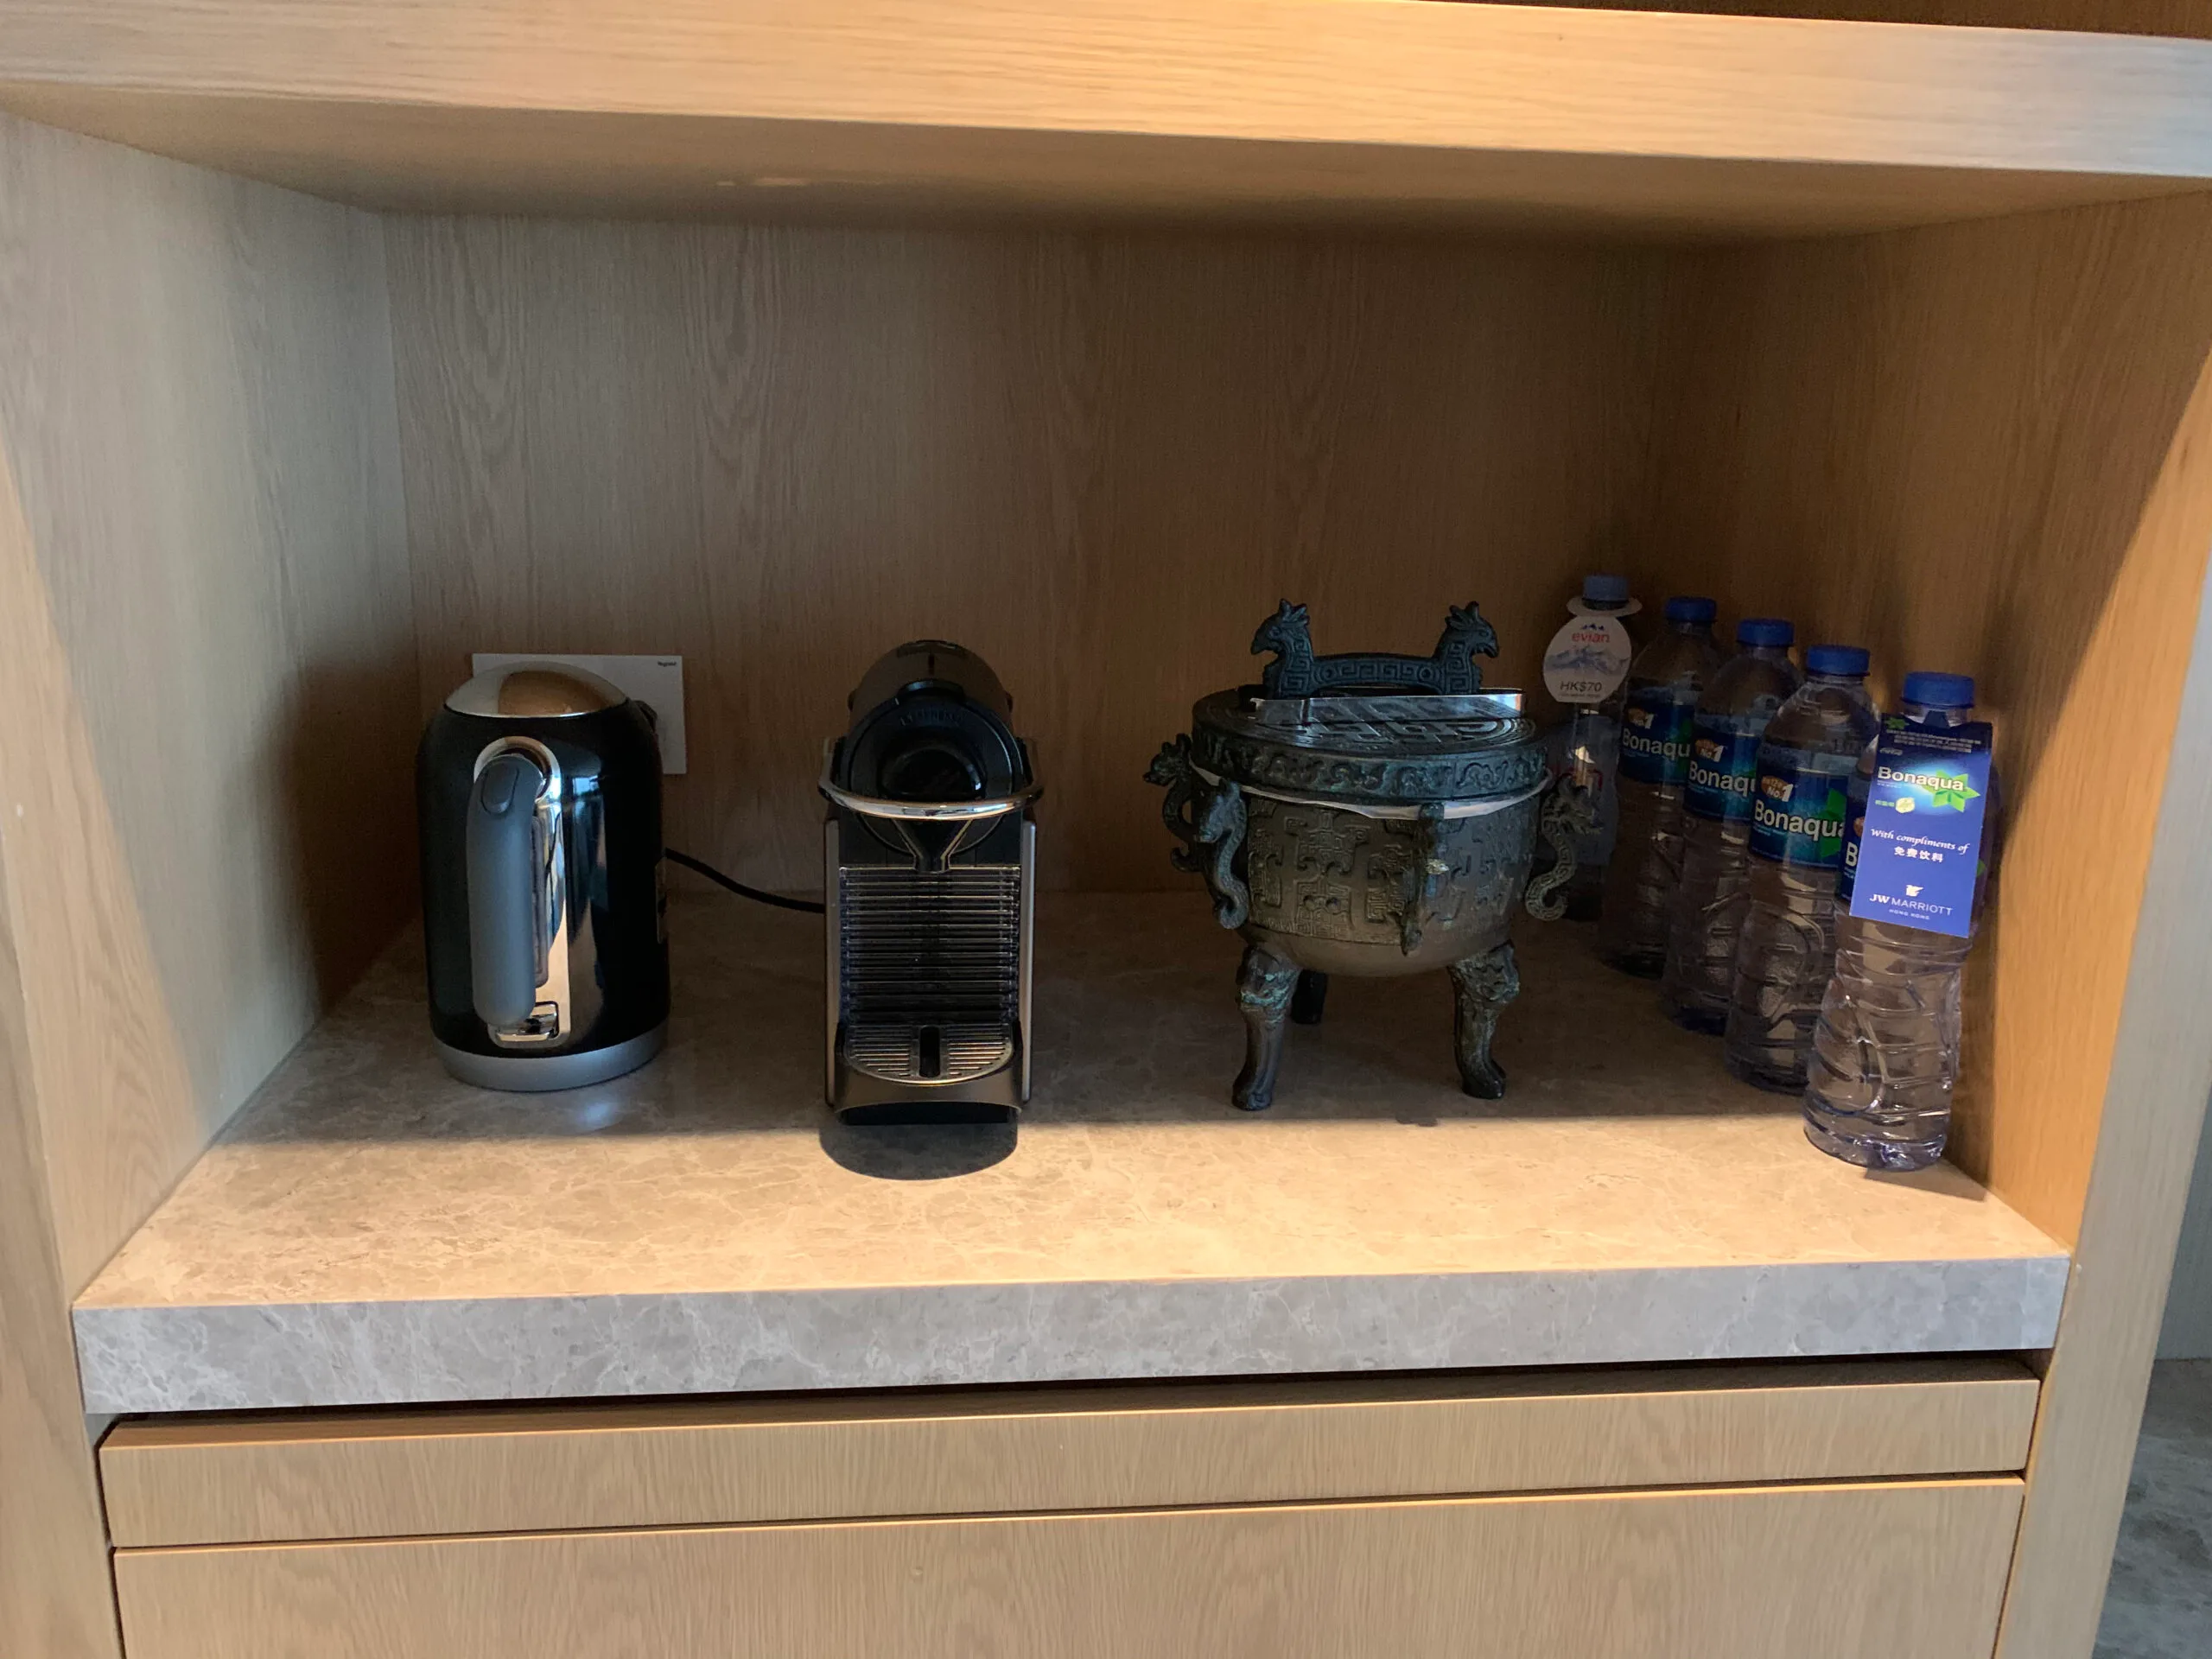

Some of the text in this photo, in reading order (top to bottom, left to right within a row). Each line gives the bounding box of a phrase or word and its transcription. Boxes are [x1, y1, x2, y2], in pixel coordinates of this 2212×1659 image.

[1572, 632, 1611, 643] evian
[1560, 681, 1602, 692] HK$70
[1623, 728, 1691, 760] Bonaqu
[1688, 761, 1756, 797] Bonaq
[1878, 766, 1964, 791] Bonaqua
[1871, 829, 1970, 855] With compliments of
[1894, 846, 1943, 863] 免费饮料
[1869, 893, 1954, 916] JW MARRIOTT
[1889, 908, 1909, 917] HONG
